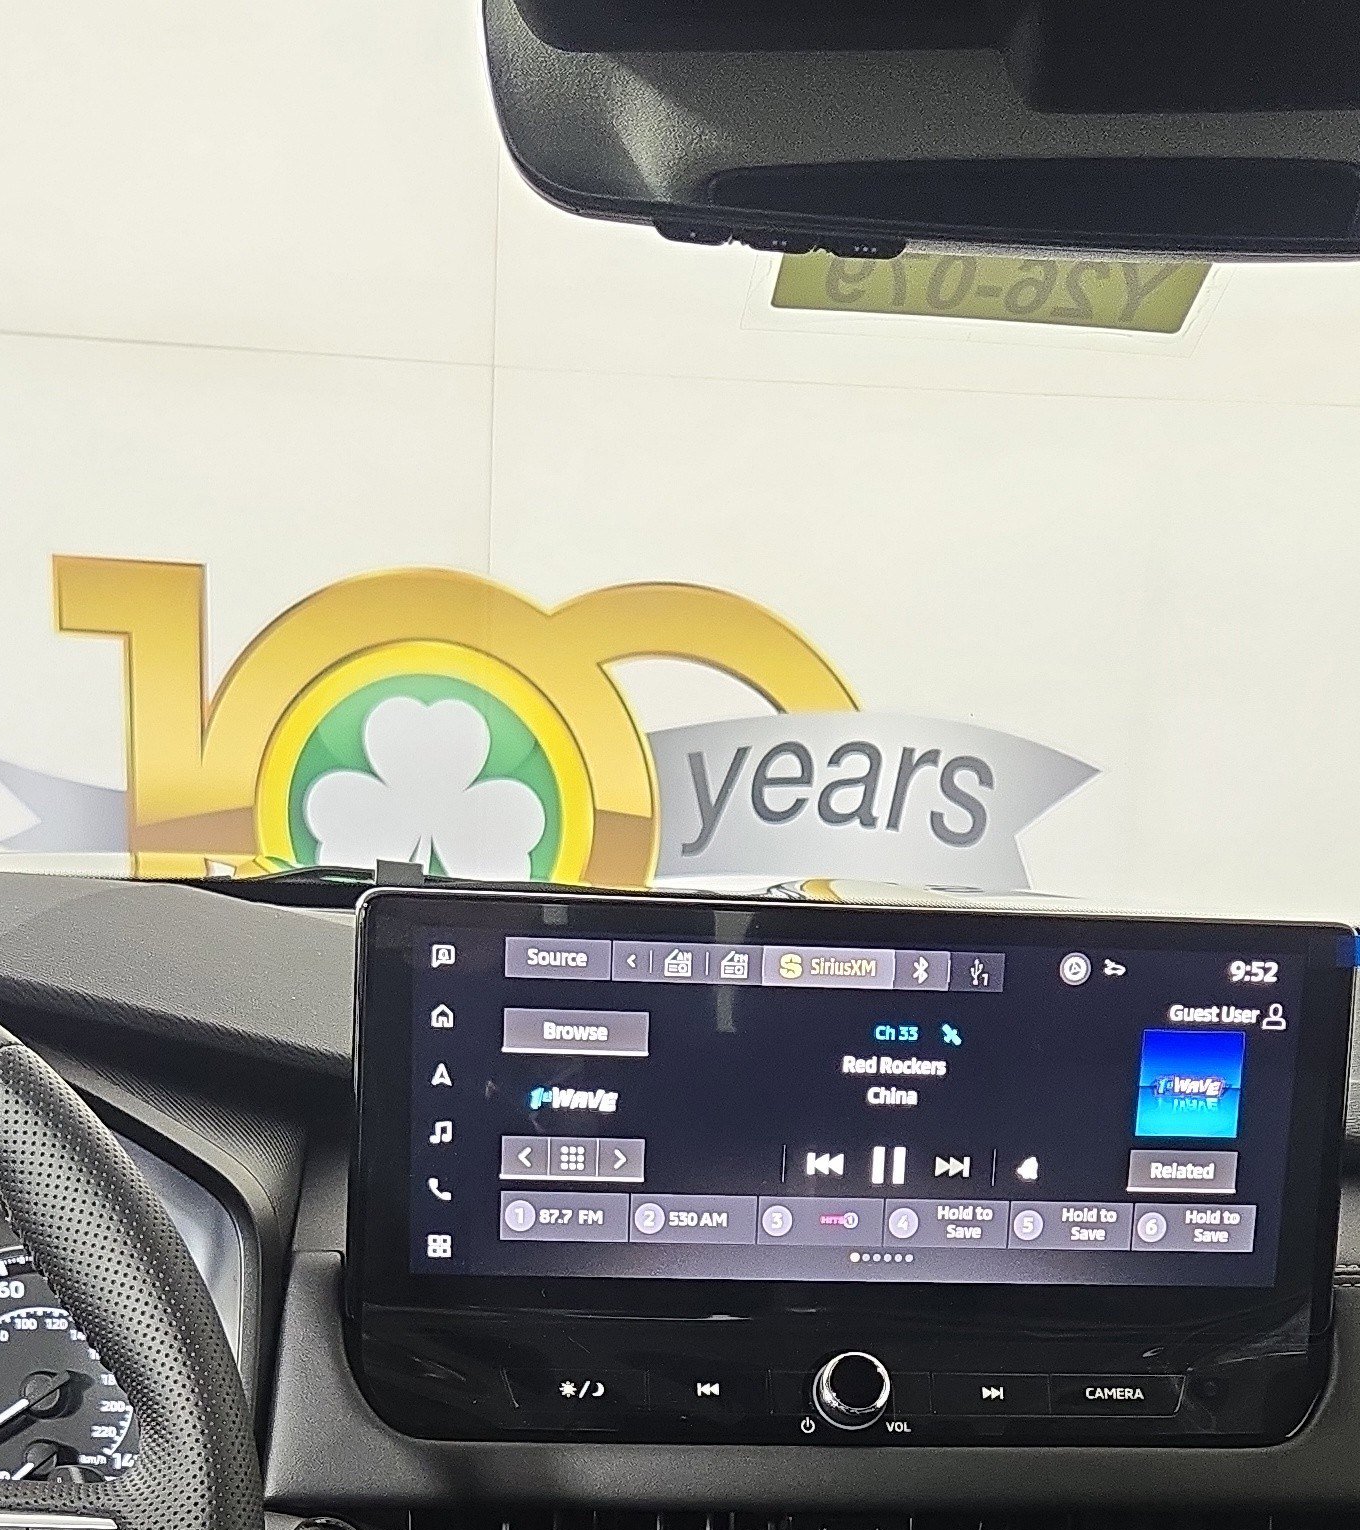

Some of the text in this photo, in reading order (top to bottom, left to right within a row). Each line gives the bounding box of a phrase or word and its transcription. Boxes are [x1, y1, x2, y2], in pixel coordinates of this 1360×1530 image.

[680, 737, 995, 858] years
[527, 948, 588, 968] Source
[810, 958, 877, 978] SiriusXM
[1230, 960, 1279, 984] 9:52
[1169, 1004, 1261, 1025] Guest User
[543, 1021, 608, 1042] Browse
[875, 1025, 919, 1041] Ch 33
[842, 1056, 948, 1077] Red Rockers
[866, 1086, 919, 1107] China
[1150, 1162, 1216, 1181] Related
[539, 1208, 574, 1226] 87.7
[578, 1209, 604, 1226] FM
[669, 1210, 698, 1227] 530
[700, 1211, 728, 1228] AM
[937, 1205, 969, 1222] Hold
[973, 1207, 993, 1222] to
[1061, 1208, 1093, 1224] Hold
[1097, 1209, 1118, 1224] to
[1185, 1210, 1217, 1226] Hold
[1220, 1211, 1240, 1226] to
[946, 1224, 982, 1240] Save
[1070, 1226, 1106, 1242] Save
[1193, 1228, 1229, 1243] Save
[1085, 1387, 1145, 1400] CAMERA
[886, 1421, 911, 1433] VOL
